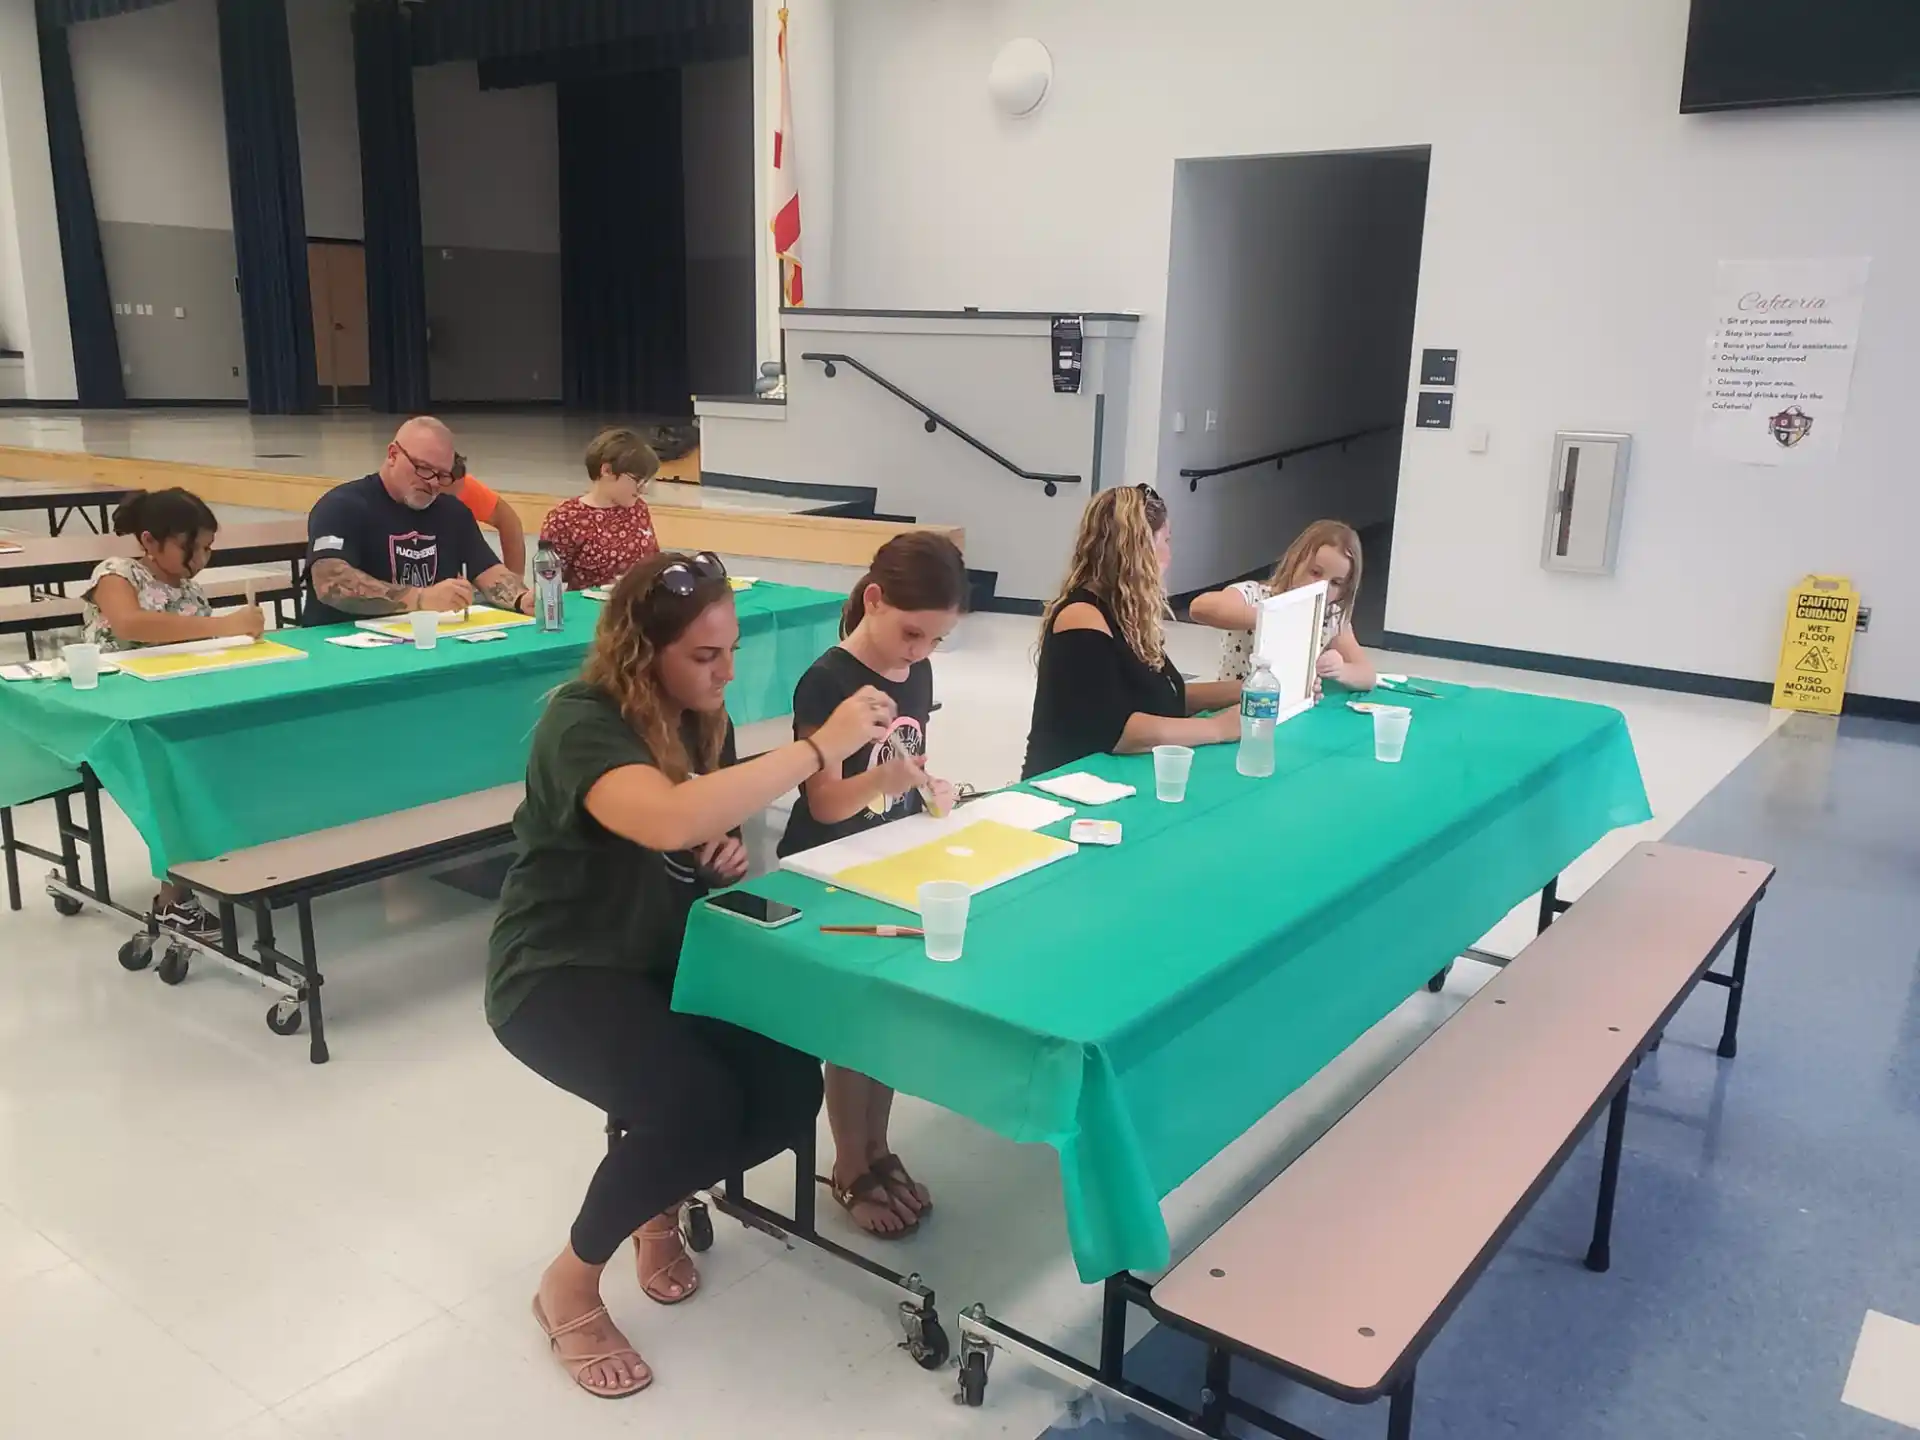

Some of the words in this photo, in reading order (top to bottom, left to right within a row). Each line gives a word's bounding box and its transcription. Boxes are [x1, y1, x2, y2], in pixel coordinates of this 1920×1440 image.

[1738, 291, 1826, 314] Cafeteria
[1727, 317, 1739, 325] Sit
[1750, 319, 1768, 327] your
[1769, 318, 1808, 327] assigned
[1725, 330, 1743, 338] Stay
[1754, 331, 1772, 339] your
[1766, 341, 1787, 349] hand
[1788, 341, 1800, 349] for
[1721, 354, 1739, 362] Only
[1740, 354, 1765, 362] utilize
[1766, 354, 1807, 363] approved
[1717, 366, 1763, 376] technology.
[1718, 378, 1741, 386] Clean
[1742, 379, 1753, 387] up
[1755, 380, 1773, 388] your
[1715, 390, 1735, 398] Food
[1754, 391, 1779, 399] drinks
[1781, 392, 1798, 401] stay
[1800, 392, 1808, 400] in
[1809, 392, 1824, 400] the
[1712, 402, 1753, 411] Cafeteria!
[1800, 595, 1848, 610] CAUTION
[1797, 606, 1846, 621] CUIDADO
[1807, 624, 1830, 633] WET
[1799, 632, 1836, 643] FLOOR
[1797, 675, 1822, 685] PISO
[1785, 682, 1832, 694] MOJADO
